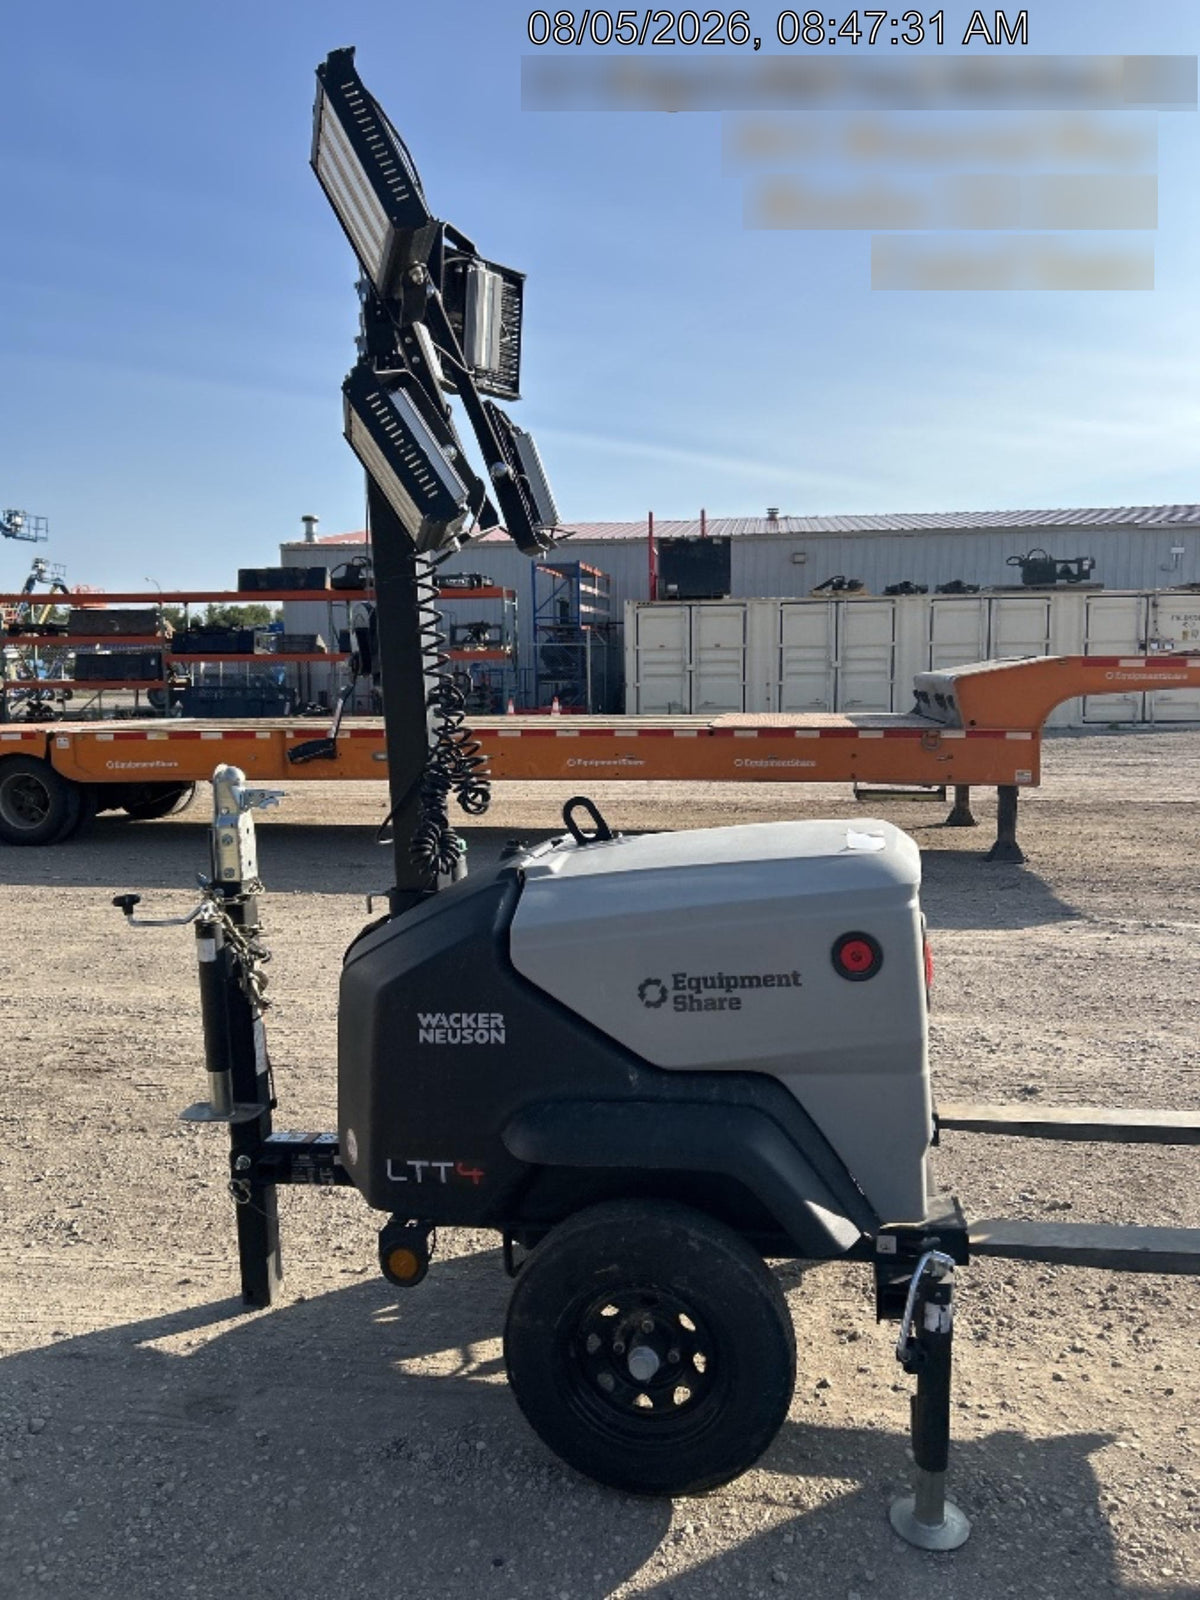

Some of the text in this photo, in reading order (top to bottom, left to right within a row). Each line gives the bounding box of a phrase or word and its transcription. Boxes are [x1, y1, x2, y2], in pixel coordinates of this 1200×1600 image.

[671, 970, 803, 994] Equipment
[672, 993, 742, 1012] Share
[417, 1012, 505, 1028] WACKER
[418, 1028, 506, 1044] NEUSON
[386, 1158, 485, 1185] LTT4
